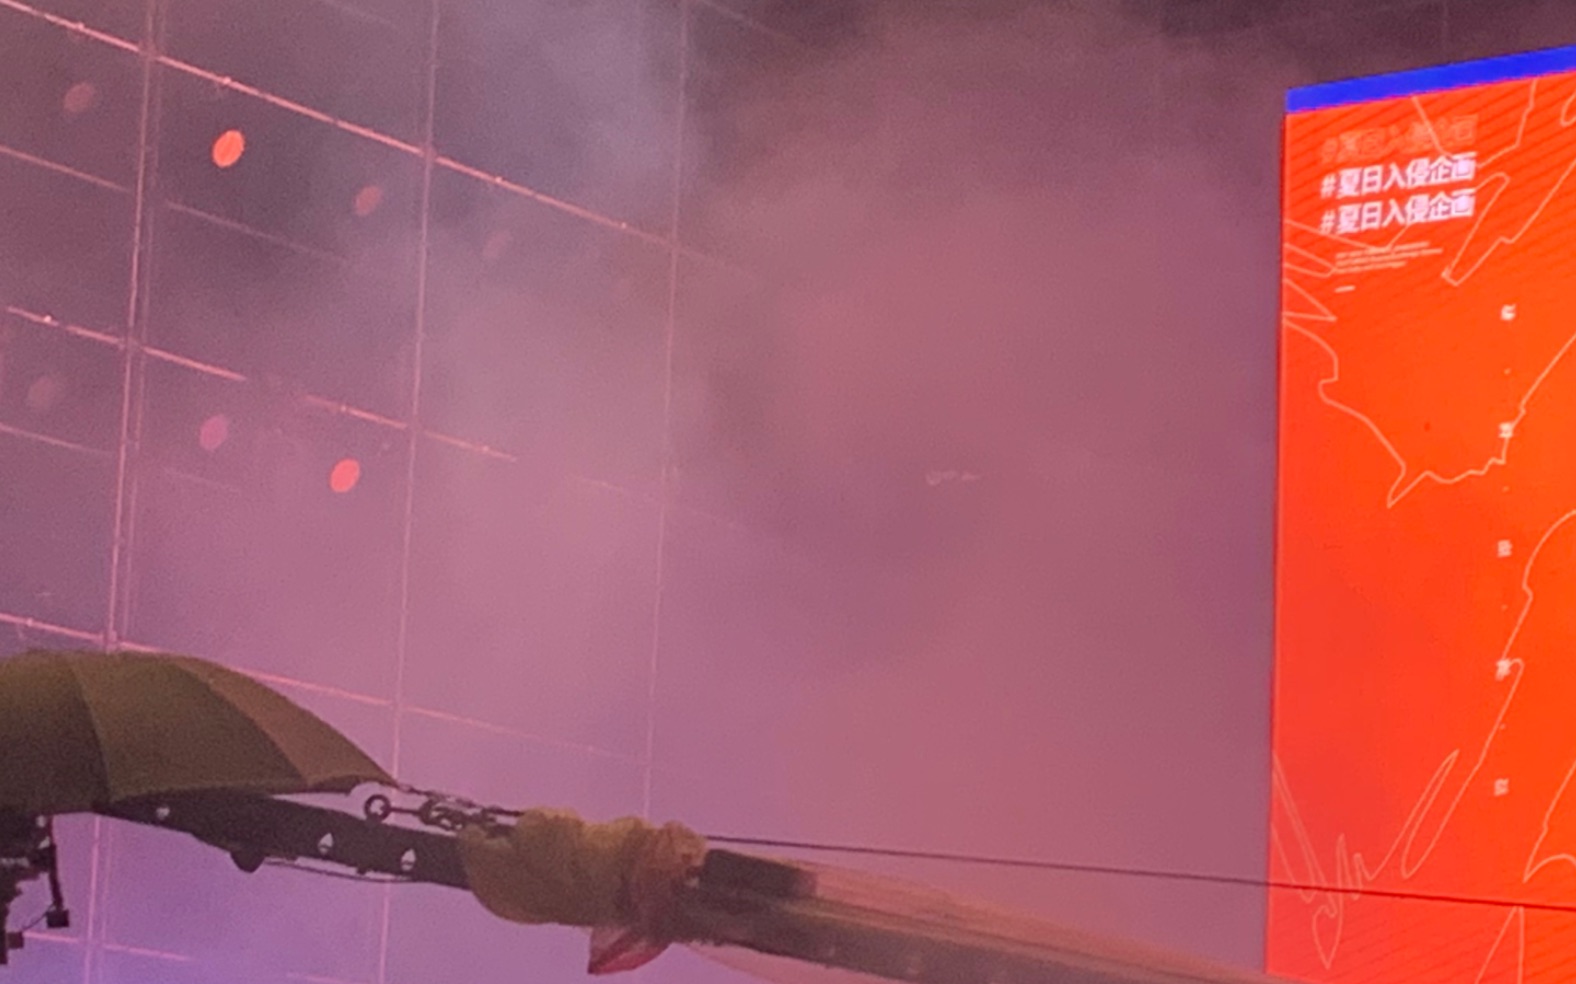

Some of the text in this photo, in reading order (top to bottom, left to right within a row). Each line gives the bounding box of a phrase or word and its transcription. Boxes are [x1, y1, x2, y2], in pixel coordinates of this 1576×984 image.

[1320, 152, 1478, 199] #夏日入侵企画
[1319, 188, 1477, 235] #夏日入侵企画
